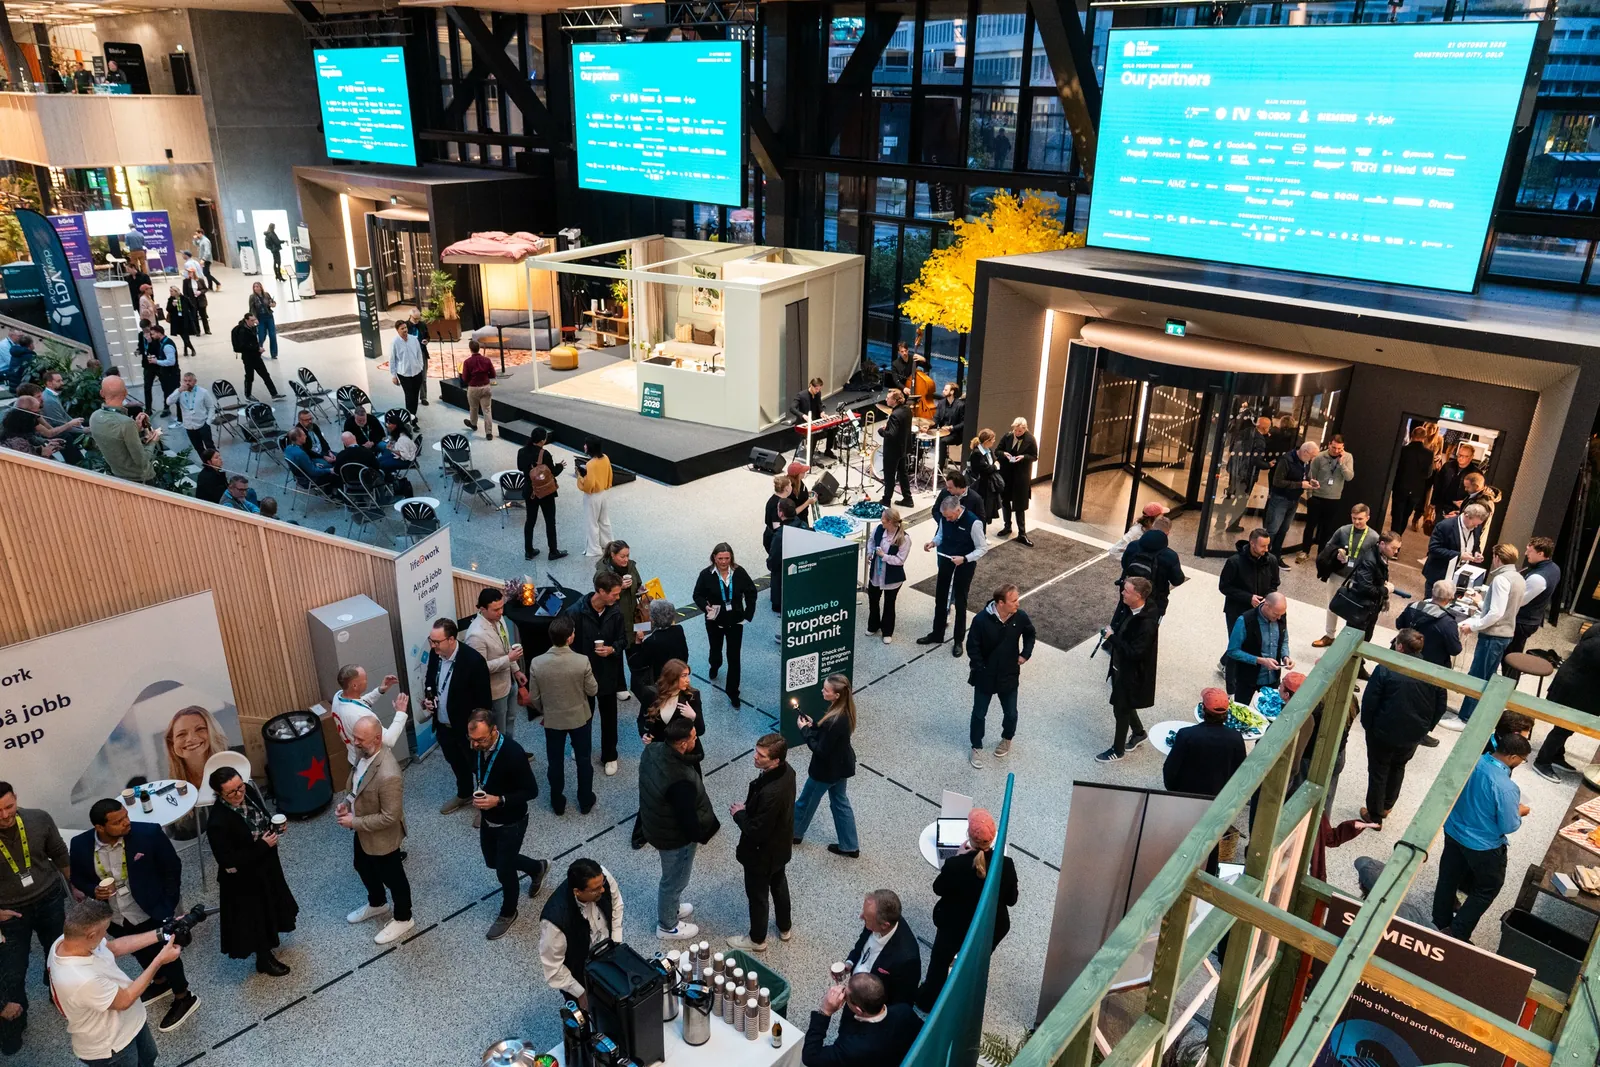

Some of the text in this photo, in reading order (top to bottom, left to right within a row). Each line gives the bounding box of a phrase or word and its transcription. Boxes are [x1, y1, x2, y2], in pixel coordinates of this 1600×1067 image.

[1121, 71, 1211, 89] Our partners
[410, 546, 440, 571] life@work
[413, 568, 442, 593] Alt på jobb
[421, 590, 428, 598] én
[429, 582, 440, 593] app
[787, 599, 839, 618] Welcome to
[787, 609, 848, 634] Proptech
[786, 625, 841, 648] Summit
[822, 648, 837, 656] Check
[830, 650, 851, 661] program
[22, 694, 71, 723] jobb
[3, 728, 44, 750] app
[1342, 912, 1445, 962] SMENS
[1350, 992, 1477, 1054] ining the real and the digital
